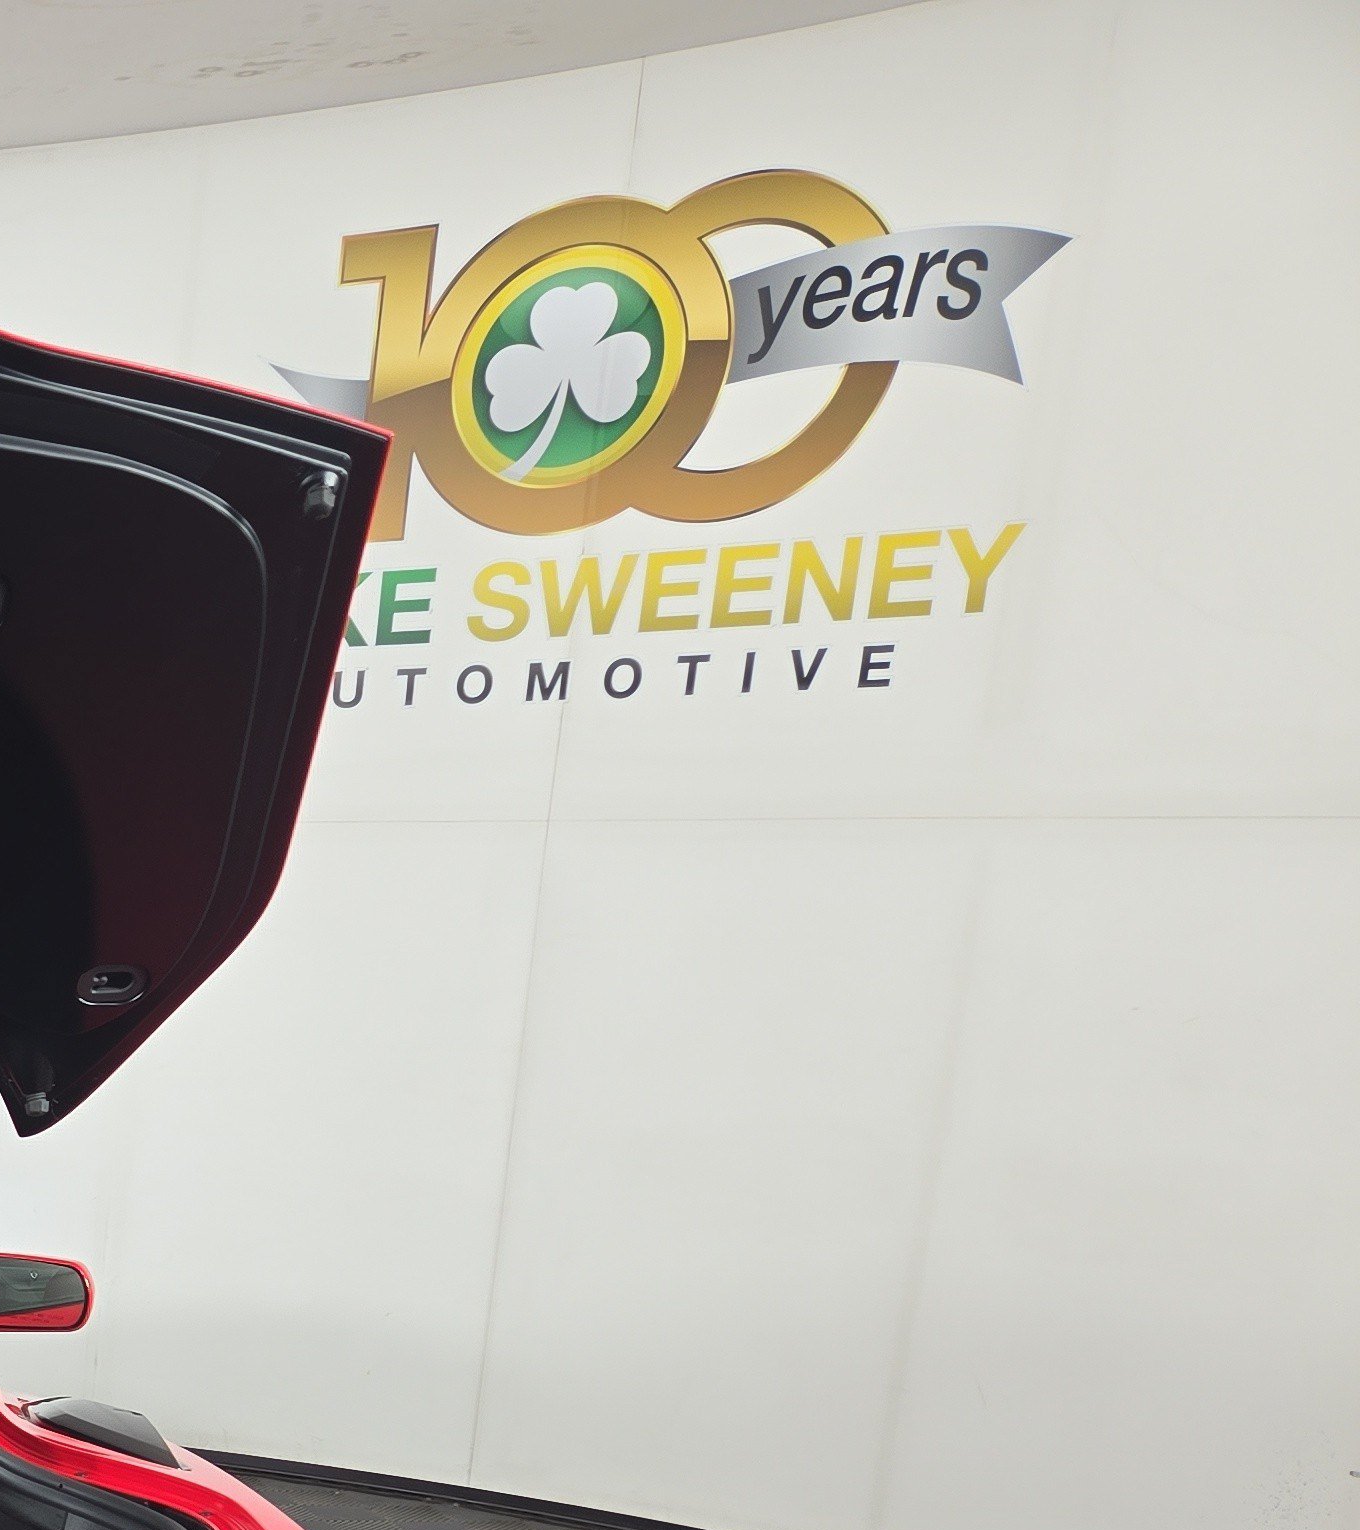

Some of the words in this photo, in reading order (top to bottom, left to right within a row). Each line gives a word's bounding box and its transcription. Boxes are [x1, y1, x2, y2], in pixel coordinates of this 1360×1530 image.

[340, 168, 897, 541] 100
[748, 246, 989, 364] years
[467, 522, 1027, 641] SWEENEY
[332, 644, 895, 709] UTOMOTIVE
